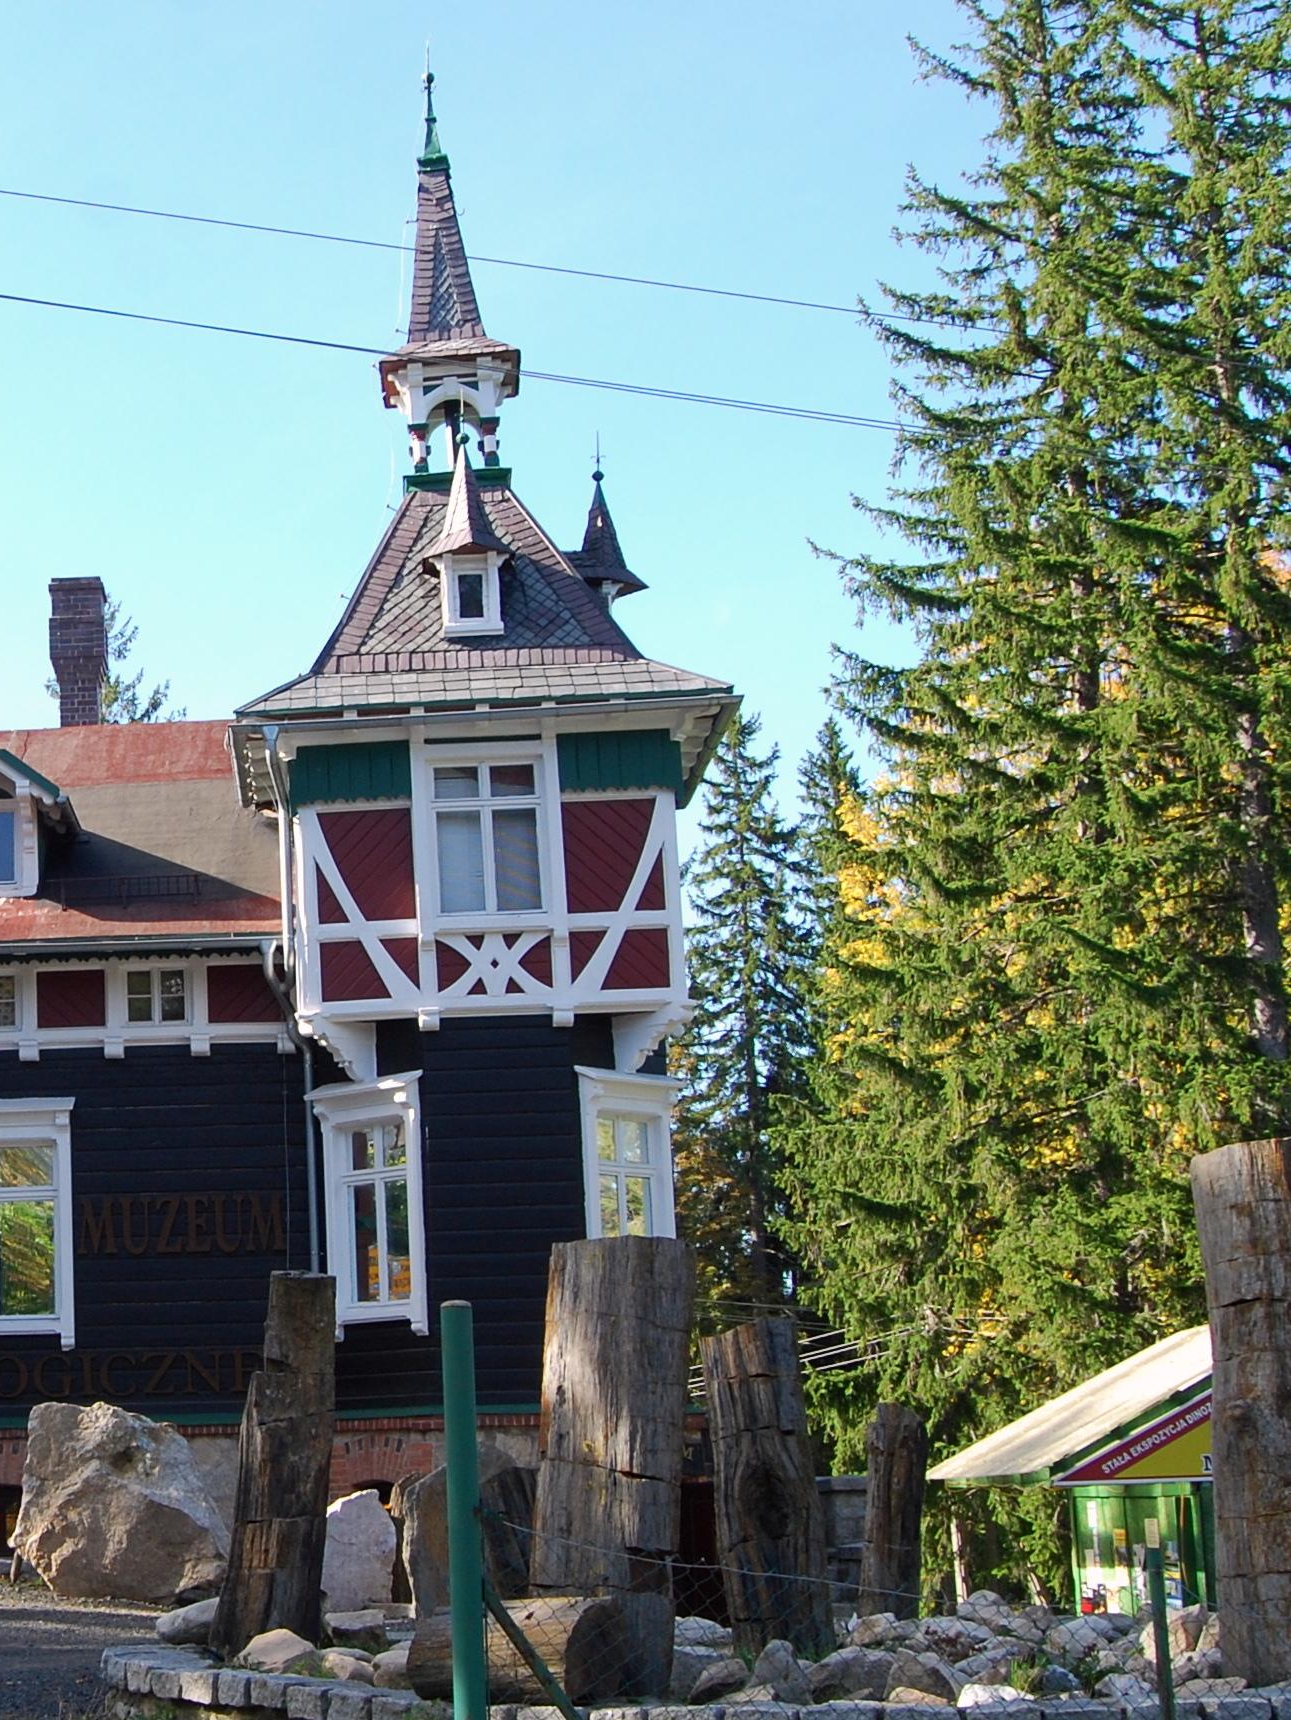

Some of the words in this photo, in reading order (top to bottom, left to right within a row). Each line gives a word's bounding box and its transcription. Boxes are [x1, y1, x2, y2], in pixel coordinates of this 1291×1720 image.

[78, 1192, 286, 1254] MUZEUM
[1101, 1453, 1132, 1474] STAŁA
[1130, 1419, 1187, 1457] EKSPOZYCJA
